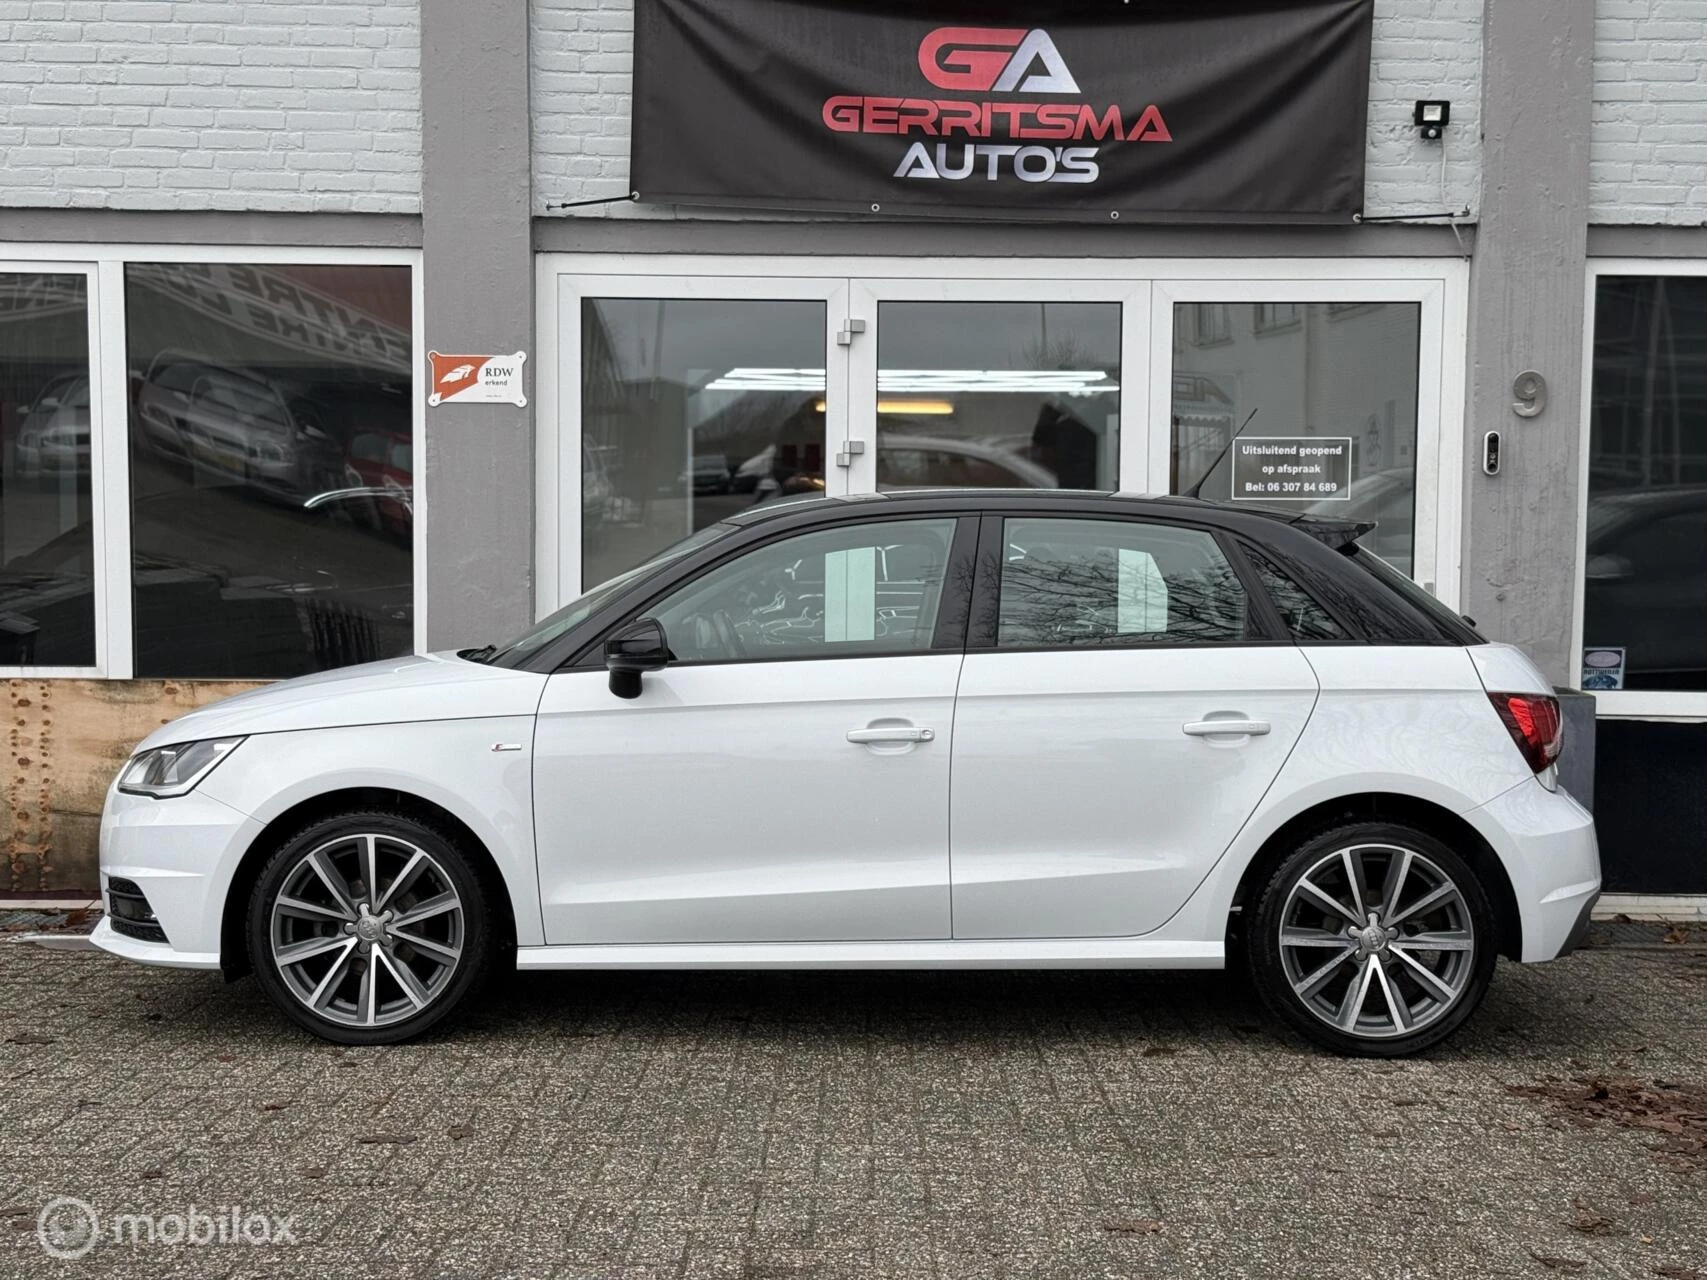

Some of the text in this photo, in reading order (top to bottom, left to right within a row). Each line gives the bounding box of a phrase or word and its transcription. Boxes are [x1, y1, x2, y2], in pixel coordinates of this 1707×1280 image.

[918, 27, 1081, 94] GA
[822, 95, 1173, 142] GERRITSMA
[893, 142, 1100, 184] AUTO'S
[485, 367, 514, 377] RDW
[1512, 369, 1548, 419] 9
[1242, 445, 1342, 457] Uitsluitend geopend
[1262, 464, 1321, 475] op afspraak
[1245, 482, 1337, 492] Bel: 06 307 84 689
